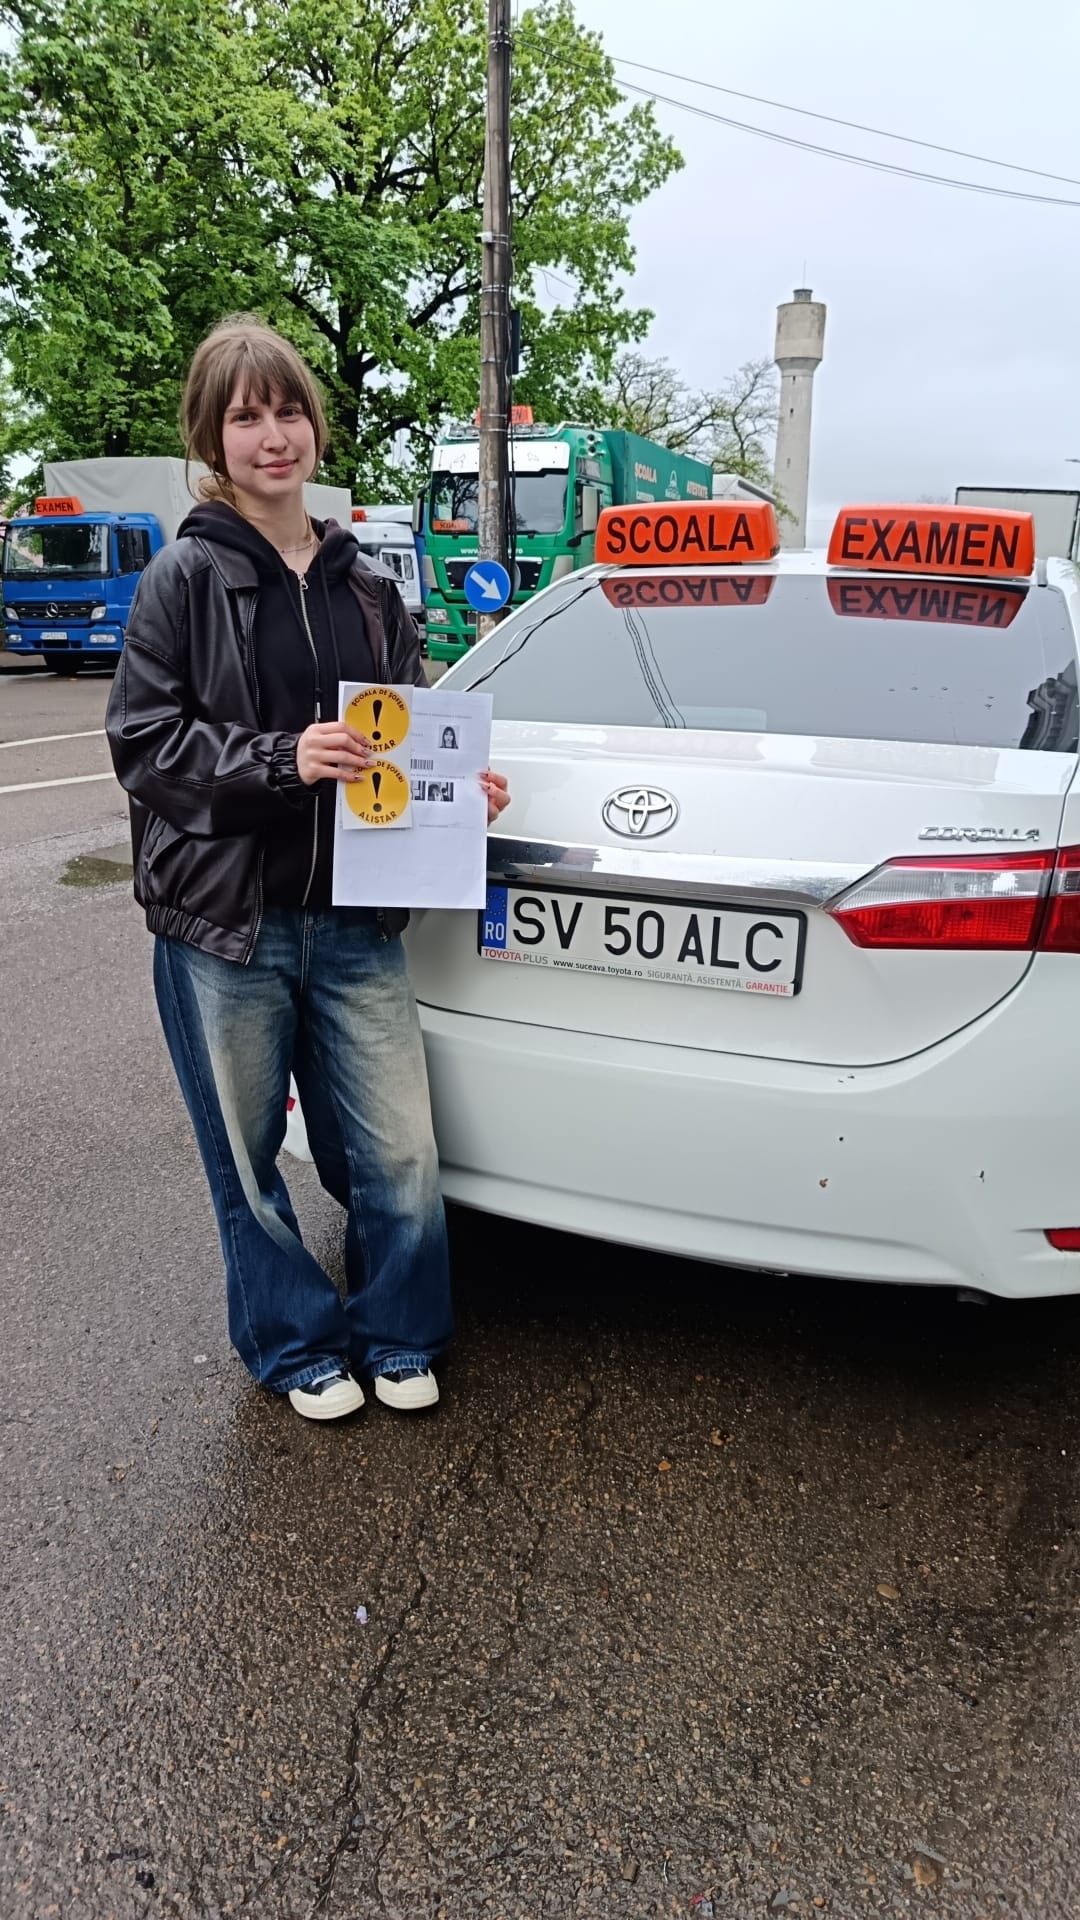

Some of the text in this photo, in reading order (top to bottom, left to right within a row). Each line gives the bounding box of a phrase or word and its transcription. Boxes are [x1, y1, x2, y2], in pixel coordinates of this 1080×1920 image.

[36, 502, 74, 513] EXAMEN
[606, 513, 755, 555] SCOALA
[841, 517, 1021, 569] EXAMEN
[376, 760, 385, 768] DE
[358, 810, 397, 824] ALISTAR
[918, 826, 1040, 842] COROLLA
[484, 921, 505, 941] RO
[512, 896, 784, 973] SV 50 ALC
[483, 948, 522, 962] TOYOTA
[523, 953, 549, 965] PLUS
[553, 960, 643, 977] www.suceava.toyota.ro
